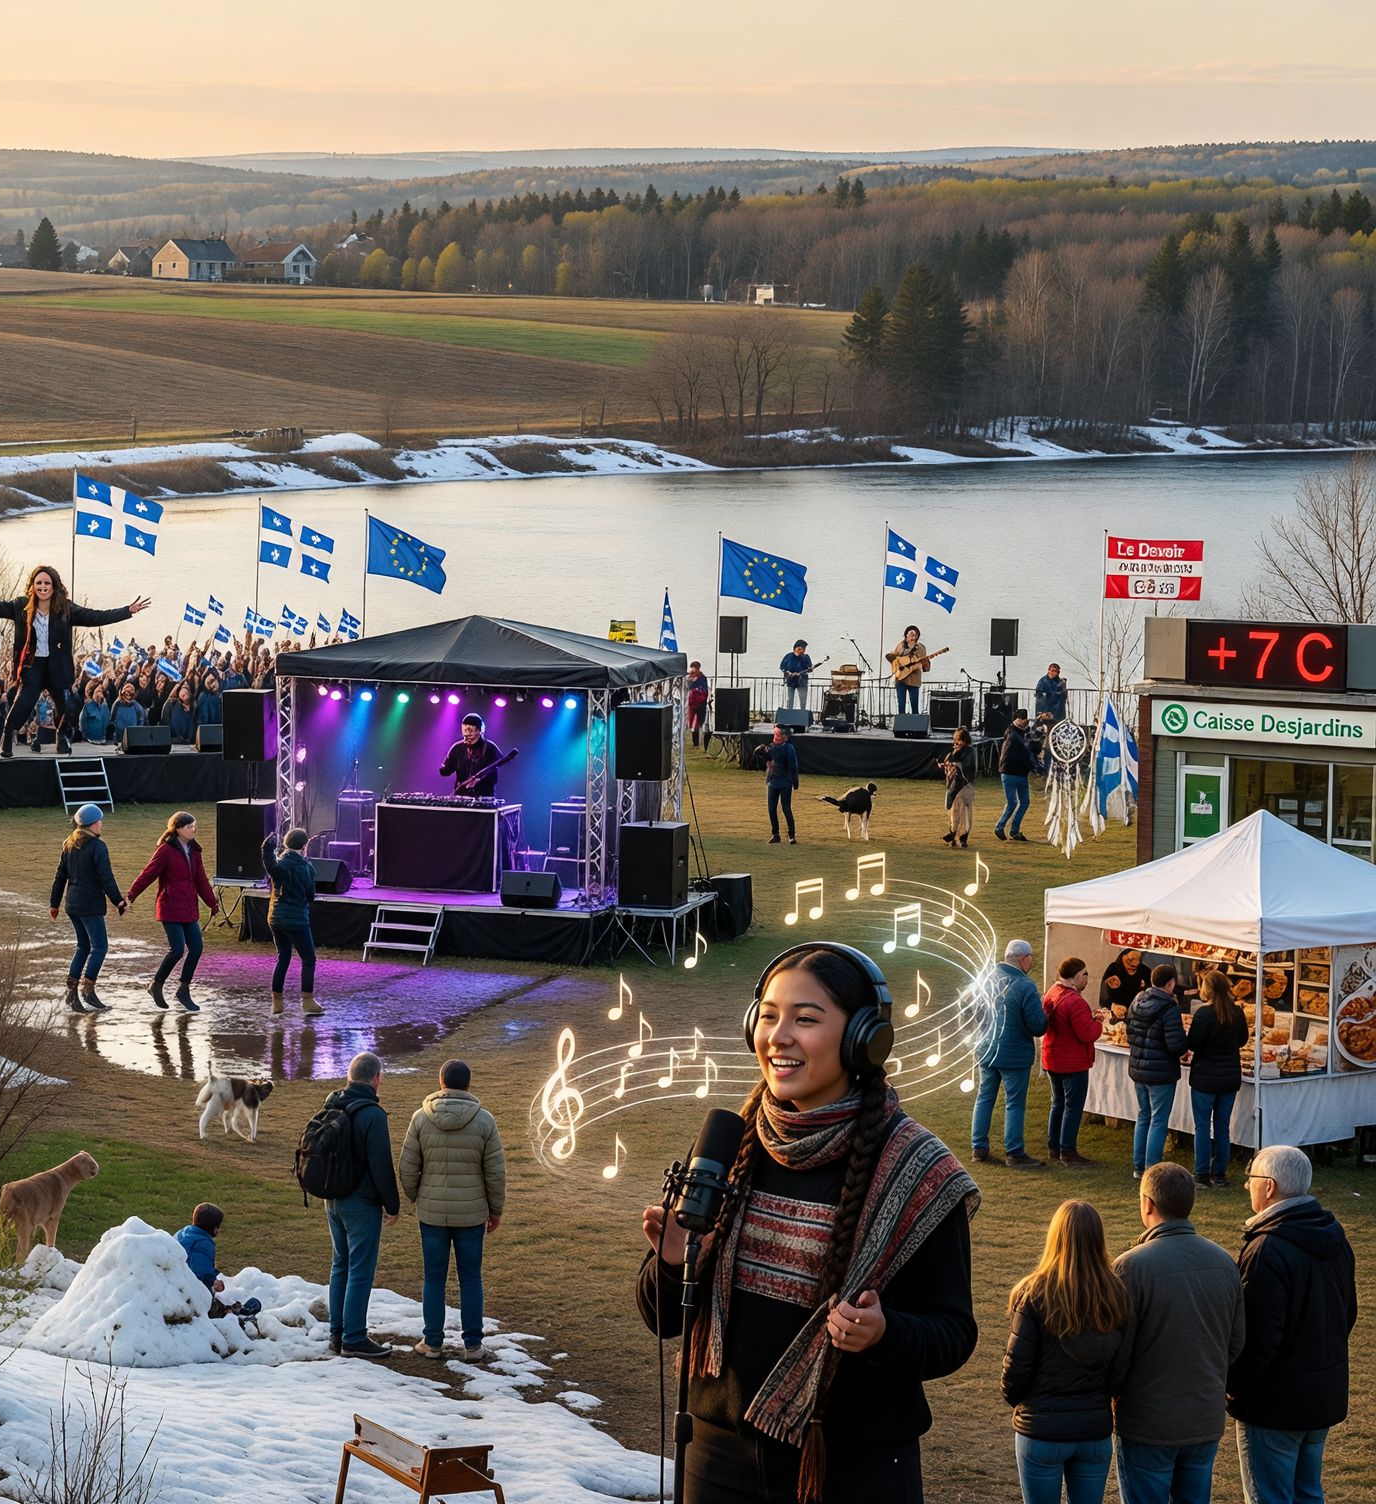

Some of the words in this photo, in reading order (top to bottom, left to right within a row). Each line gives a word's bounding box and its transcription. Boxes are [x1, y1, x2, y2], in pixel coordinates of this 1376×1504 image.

[1116, 541, 1135, 556] Le
[1138, 542, 1185, 559] Devoir
[1296, 632, 1334, 683] C
[1193, 710, 1255, 732] Caisse
[1261, 714, 1363, 740] Desjardins
